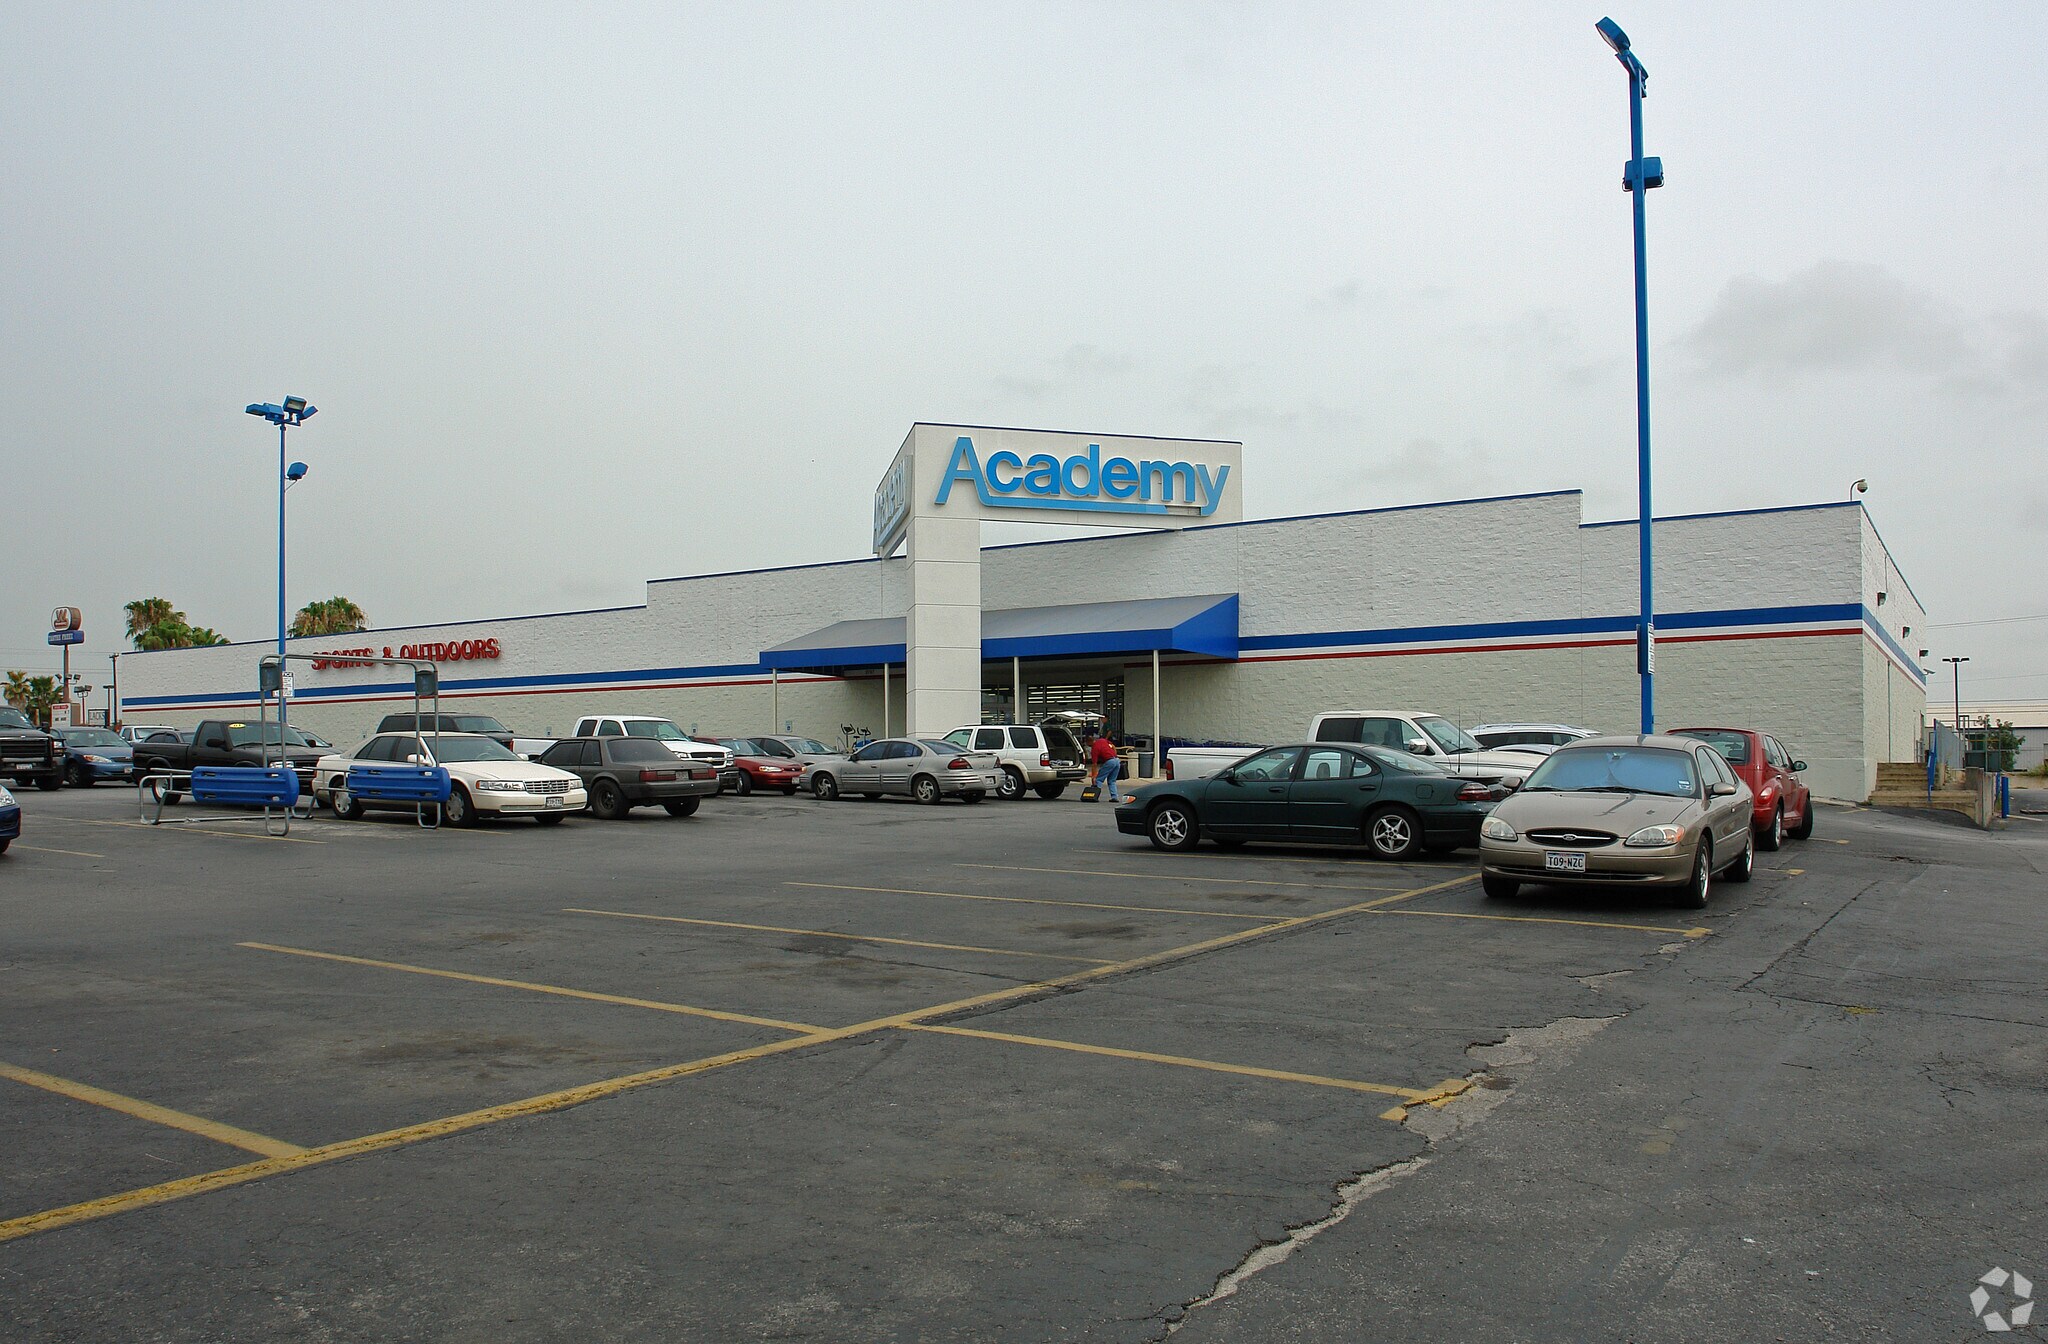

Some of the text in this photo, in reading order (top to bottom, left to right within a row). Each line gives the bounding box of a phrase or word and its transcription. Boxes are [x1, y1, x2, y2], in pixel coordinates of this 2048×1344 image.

[934, 436, 1231, 516] Academy
[311, 637, 500, 670] SPORTS & OUTDOORS
